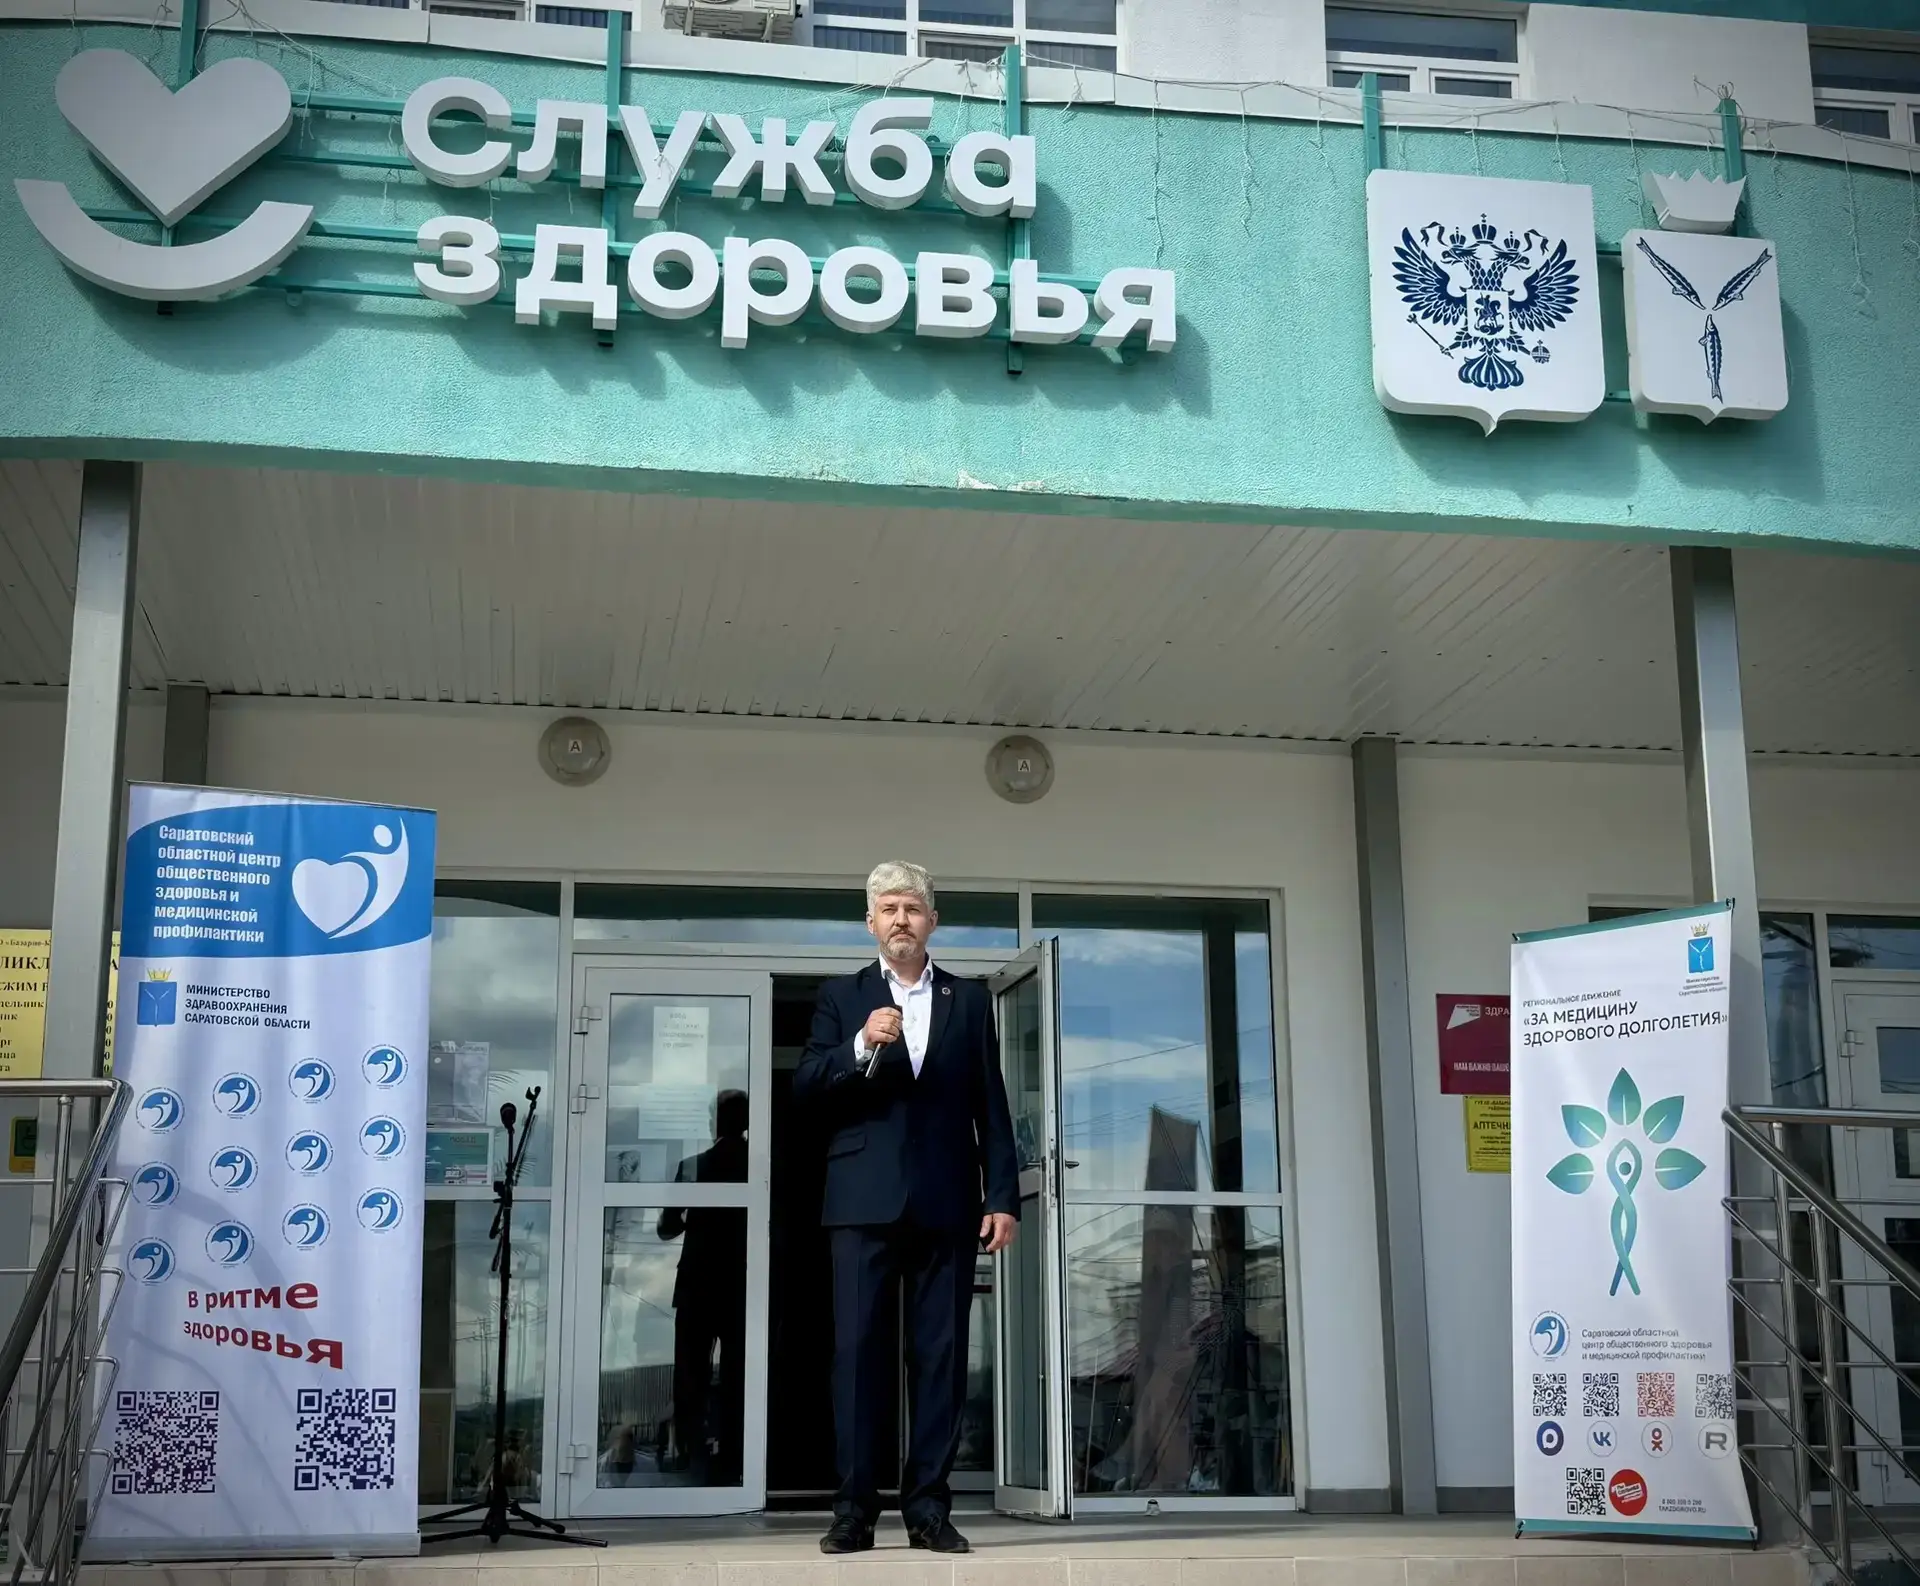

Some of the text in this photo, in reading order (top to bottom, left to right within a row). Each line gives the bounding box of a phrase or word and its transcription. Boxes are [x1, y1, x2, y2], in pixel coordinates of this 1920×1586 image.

[401, 76, 1036, 219] Служба
[413, 215, 1177, 353] здоровья
[159, 825, 254, 845] Саратовский
[158, 846, 281, 868] областной центр
[156, 866, 270, 885] общественного
[155, 886, 239, 902] здоровья и
[154, 906, 258, 923] медицинской
[153, 924, 264, 943] профилактики
[186, 984, 270, 999] МИНИСТЕРСТВО
[1523, 989, 1621, 1008] РЕГИОНАЛЬНОЕ ДВИЖЕНИЕ
[185, 999, 287, 1014] ЗДРАВООХРАНЕНИЯ
[1485, 1007, 1509, 1016] ЗДРА
[1524, 1001, 1638, 1027] «ЗА МЕДИЦИНУ
[184, 1013, 311, 1030] САРАТОВСКОЙ ОБЛАСТИ
[1523, 1011, 1728, 1047] ЗДОРОВОГО ДОЛГОЛЕТИЯ»
[1473, 1121, 1510, 1129] АПТЕЧН
[205, 1282, 318, 1313] ритме
[1581, 1328, 1679, 1339] Саратовский областной
[183, 1321, 343, 1369] здоровья
[1582, 1340, 1712, 1350] центр общественного здоровья
[1589, 1351, 1640, 1361] медицинской
[1641, 1351, 1706, 1361] профилактики
